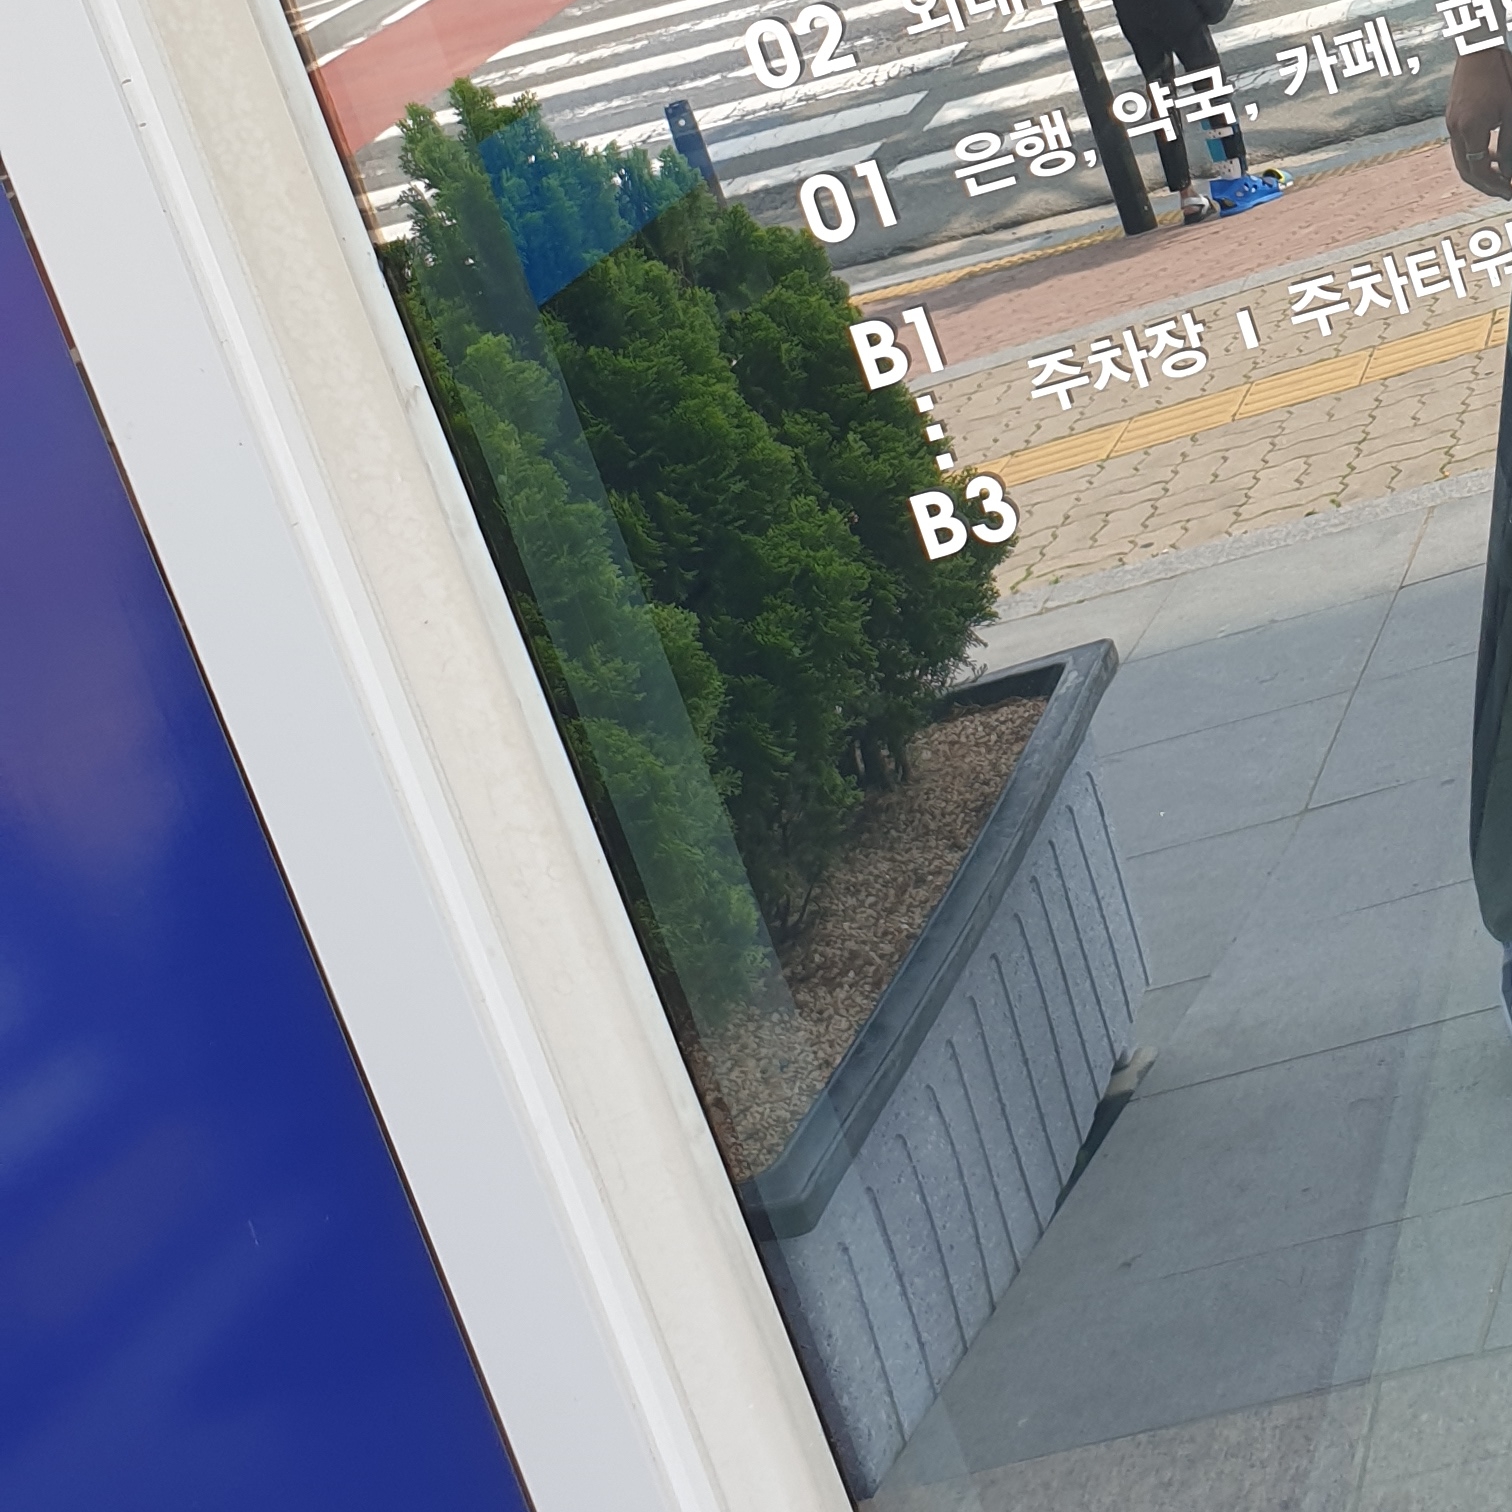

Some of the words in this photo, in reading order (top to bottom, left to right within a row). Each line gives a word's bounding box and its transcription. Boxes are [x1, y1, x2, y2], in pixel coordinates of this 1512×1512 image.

[744, 3, 858, 90] 02
[800, 159, 898, 243] 01
[954, 108, 1097, 199] 은행,
[1111, 66, 1259, 144] 약국,
[1275, 15, 1421, 97] 카페,
[849, 306, 944, 390] B1
[1027, 310, 1208, 410] 주차장
[910, 472, 1018, 560] B3
